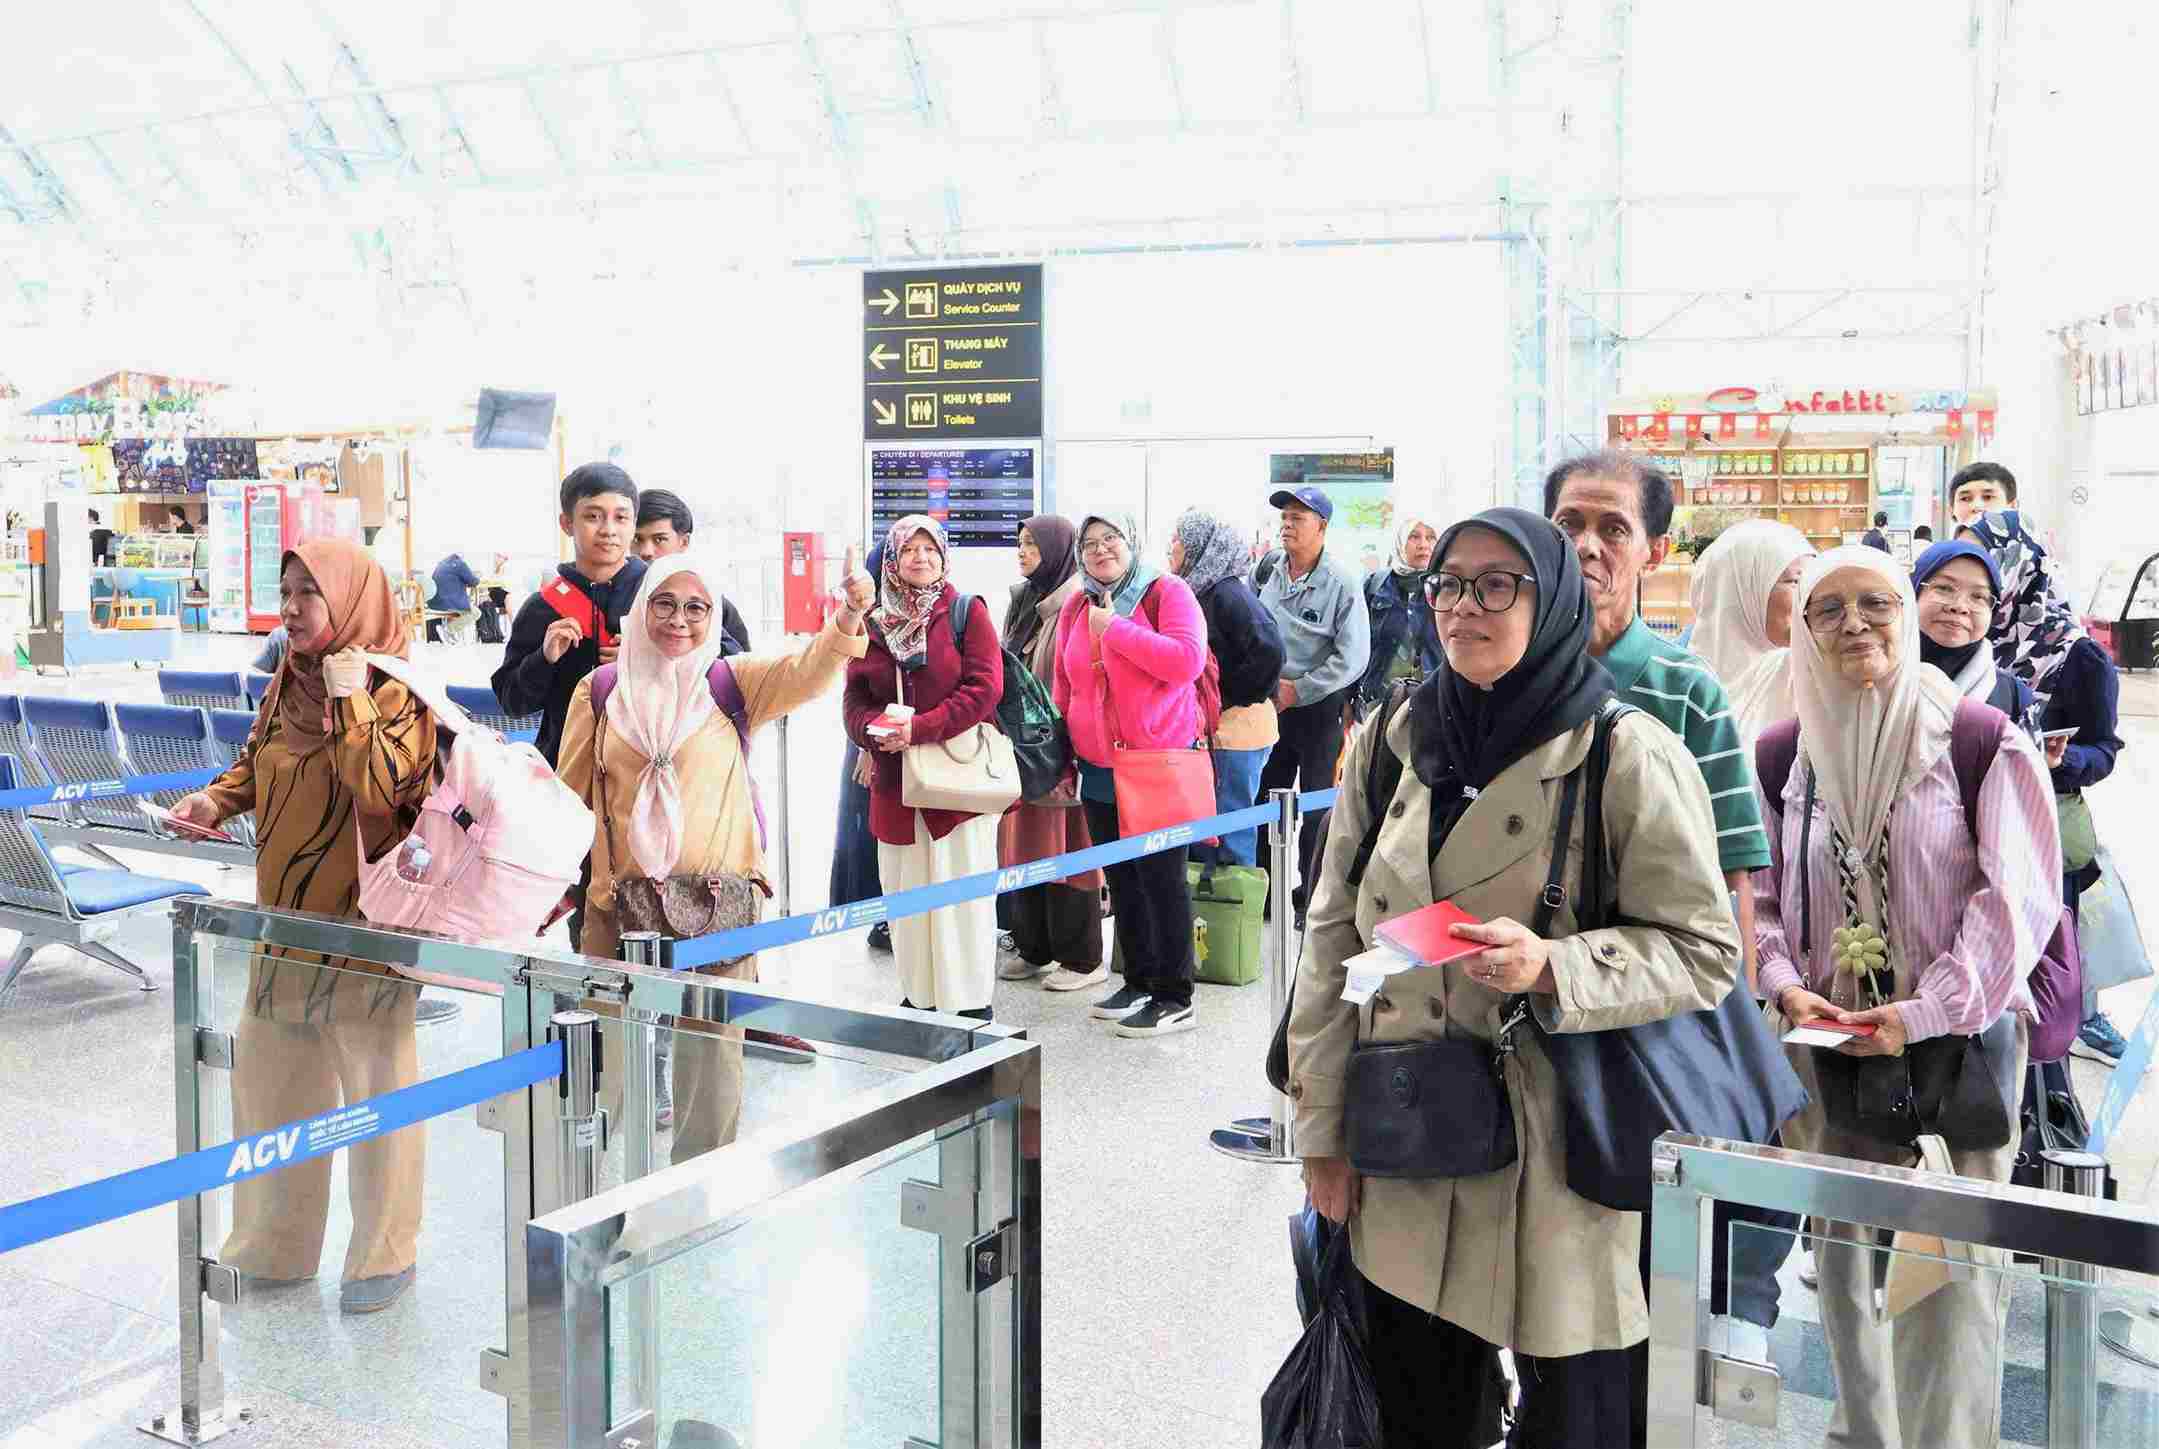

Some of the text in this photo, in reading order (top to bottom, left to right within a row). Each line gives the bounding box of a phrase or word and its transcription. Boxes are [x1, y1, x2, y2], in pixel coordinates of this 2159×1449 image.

[944, 302, 1021, 314] Service Counter
[943, 338, 982, 350] THANG
[944, 359, 983, 370] Elevator
[943, 393, 966, 405] KHU
[985, 392, 1011, 404] SINH
[944, 414, 976, 425] Toilets
[51, 783, 87, 800] ACV
[1144, 832, 1169, 853] ACV
[994, 867, 1025, 890] ACV
[810, 908, 848, 936] ACV
[225, 1125, 302, 1178] ACV
